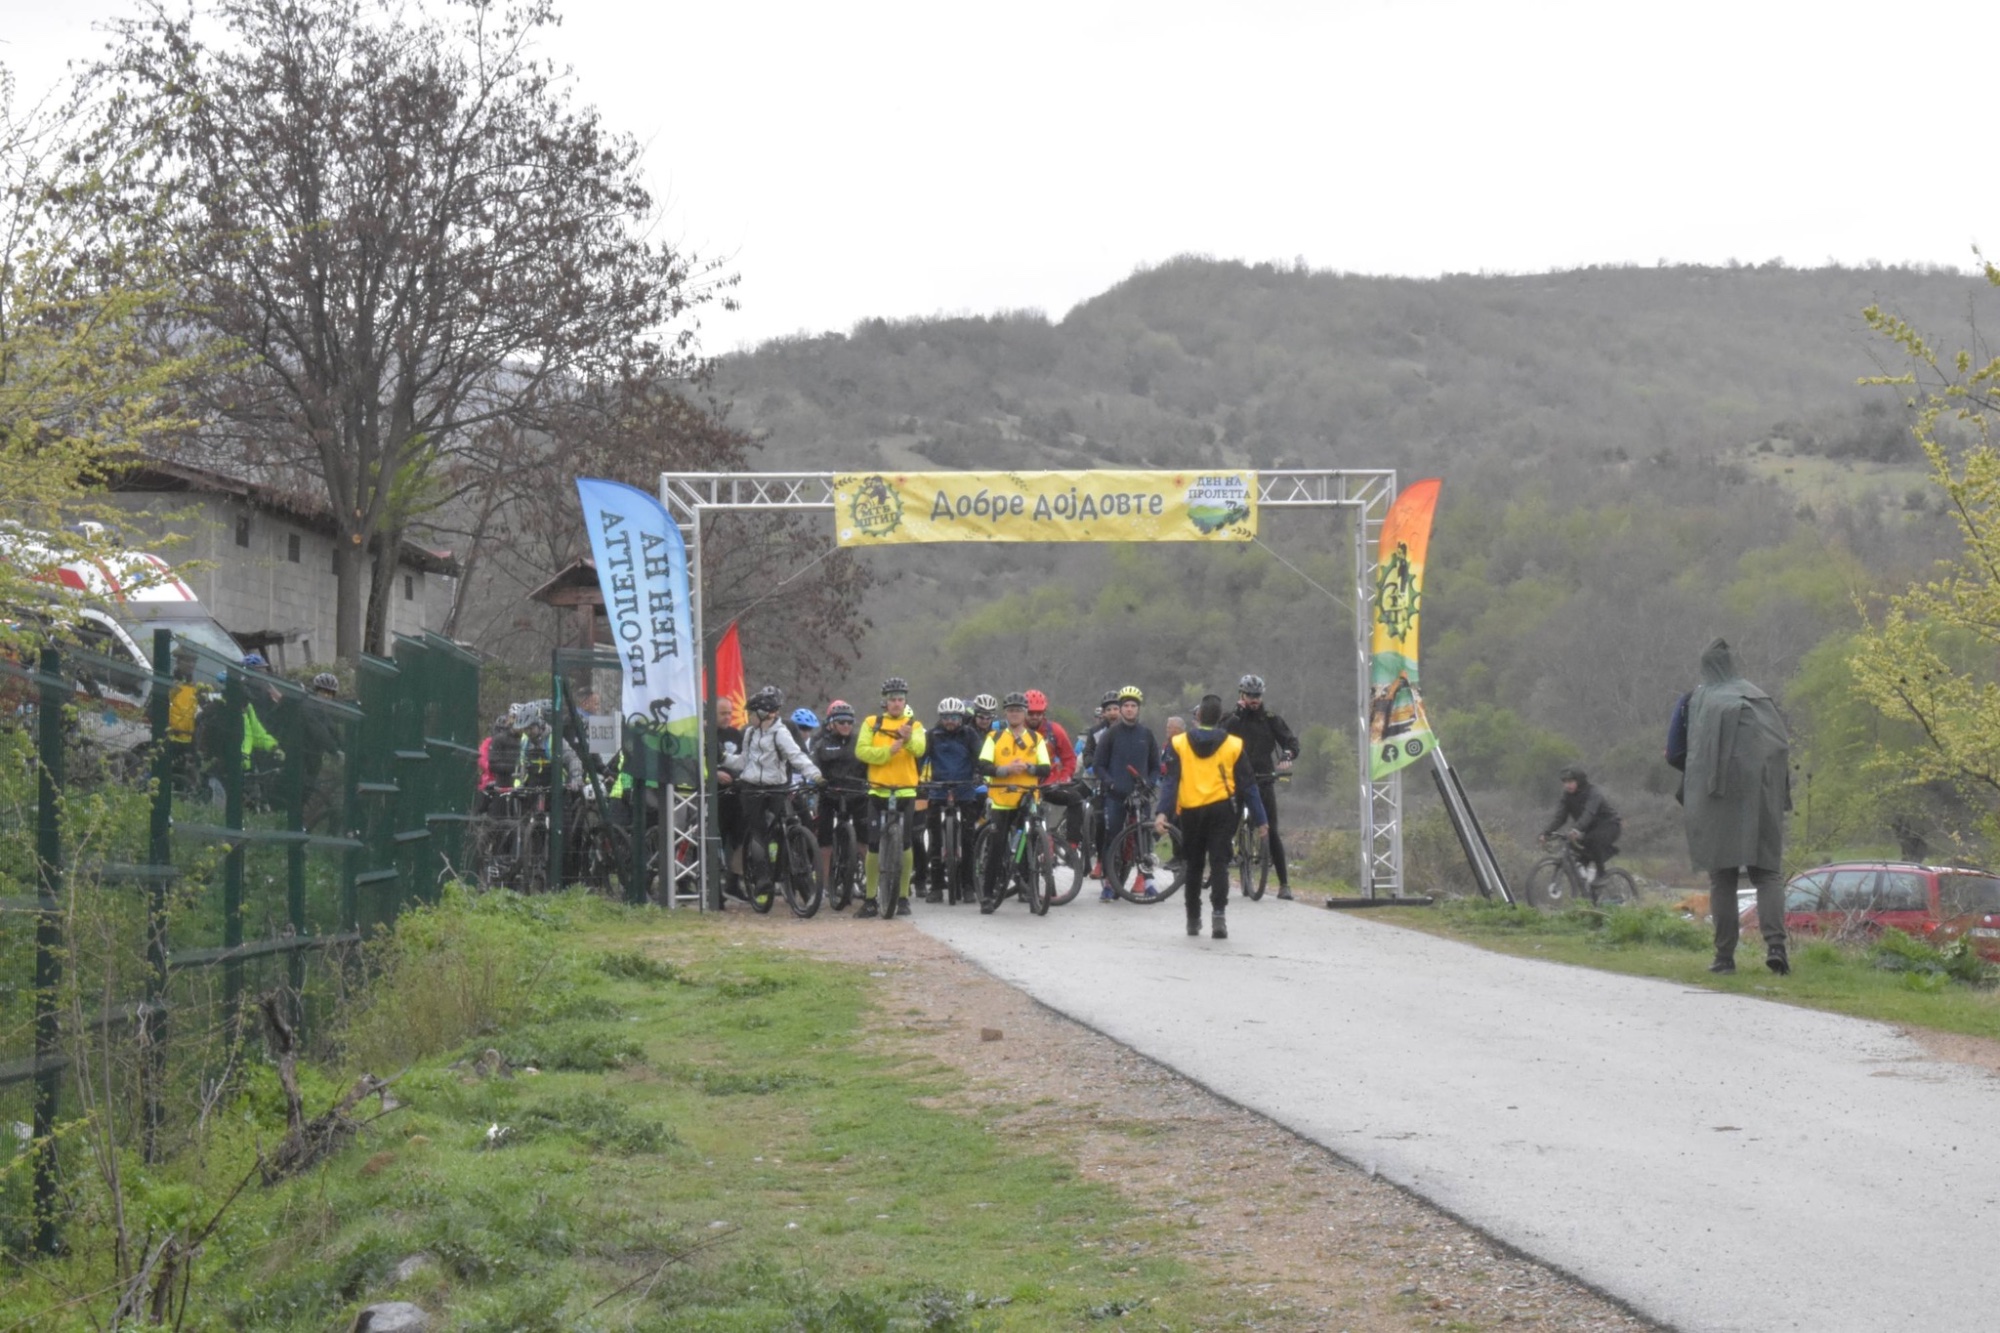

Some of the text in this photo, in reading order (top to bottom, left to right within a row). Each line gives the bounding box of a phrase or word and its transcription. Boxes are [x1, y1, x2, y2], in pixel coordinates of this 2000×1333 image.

[1196, 476, 1243, 487] ДЕН НА
[1188, 489, 1252, 499] ПРОЛЕТТА
[930, 486, 1162, 522] Добре дојдовте
